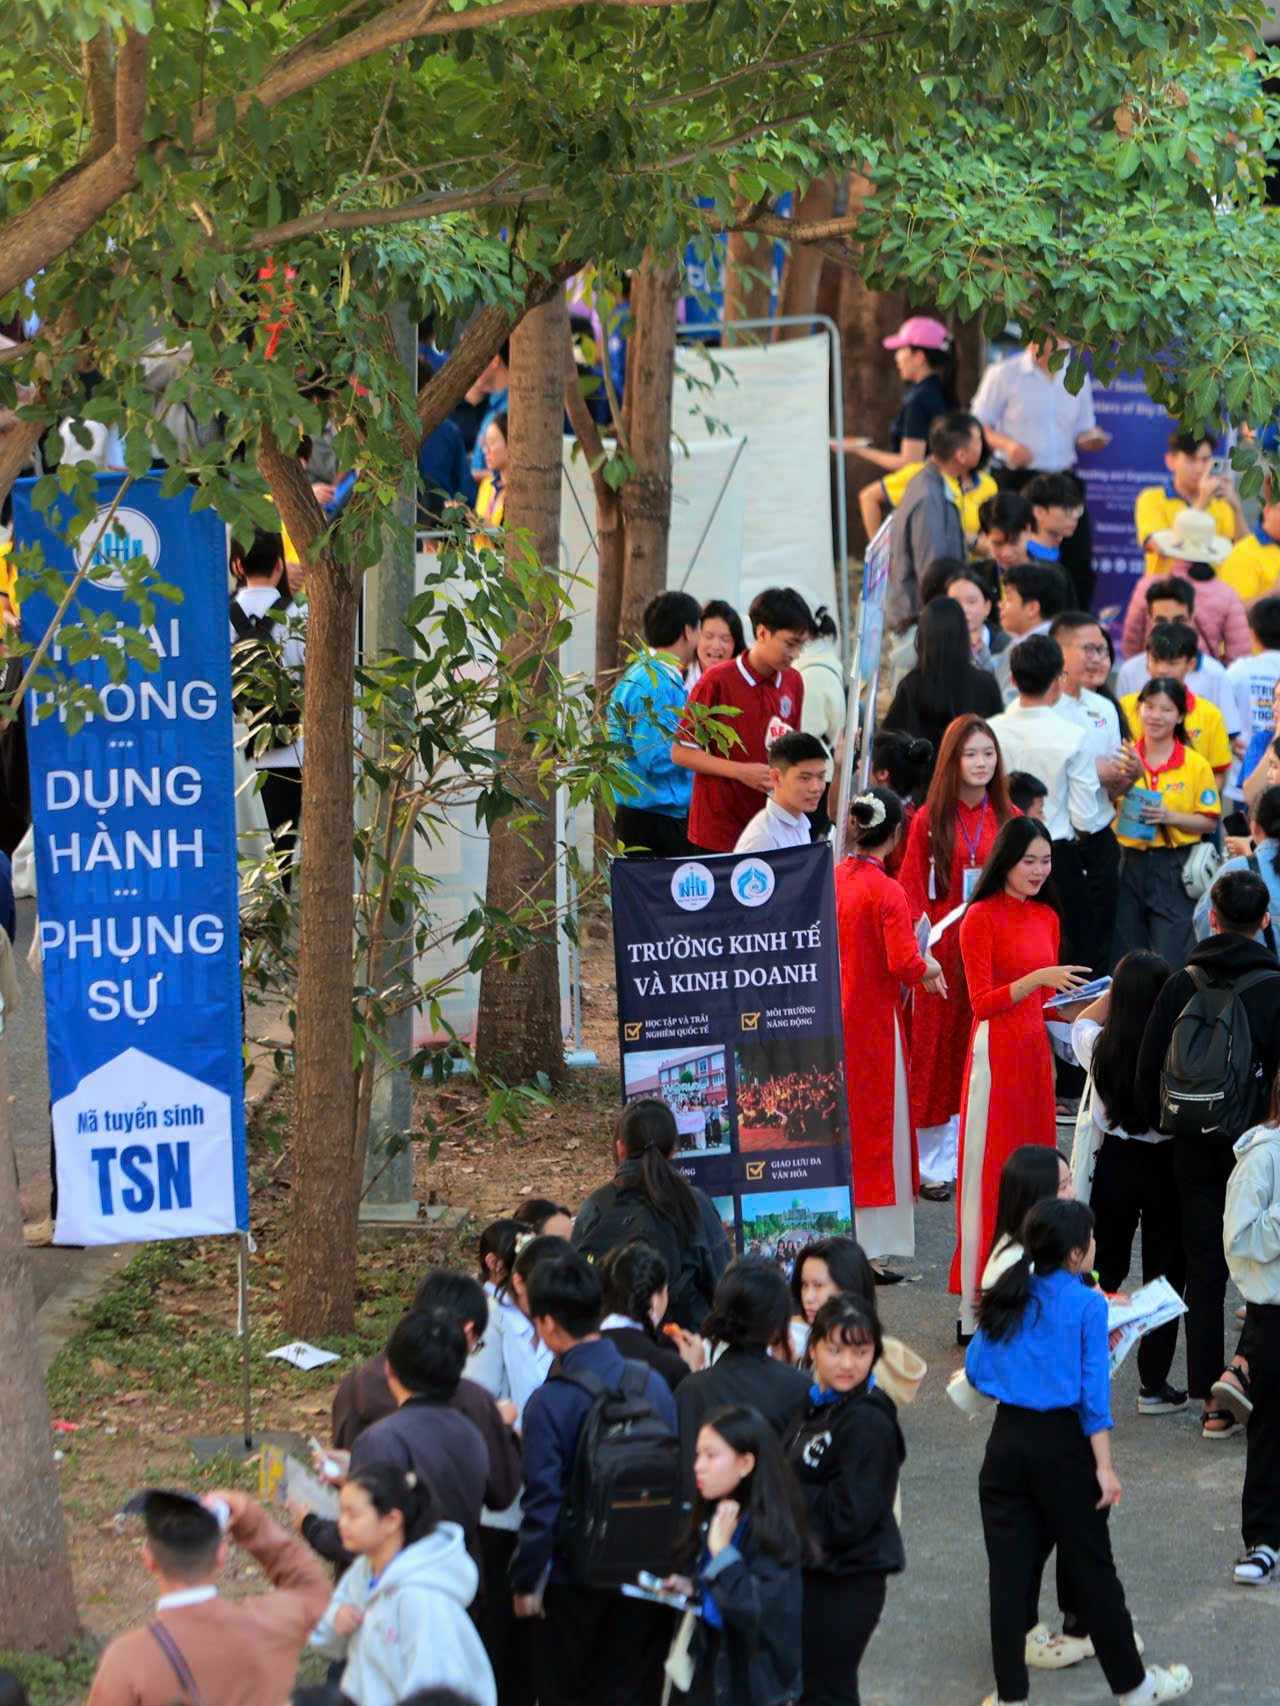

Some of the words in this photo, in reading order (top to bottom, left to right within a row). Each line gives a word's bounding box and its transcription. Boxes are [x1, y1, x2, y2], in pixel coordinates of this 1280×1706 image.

[46, 765, 202, 815] DỤNG
[49, 821, 204, 874] HÀNH
[40, 913, 225, 964] PHỤNG
[627, 934, 724, 963] TRƯỜNG
[728, 930, 787, 955] KINH
[792, 920, 821, 949] TẾ
[88, 972, 163, 1025] SỰ
[633, 970, 666, 997] VÀ
[670, 971, 728, 994] KINH
[734, 963, 818, 989] DOANH
[104, 1101, 158, 1134] tuyển
[163, 1103, 204, 1126] sinh
[91, 1141, 192, 1216] TSN
